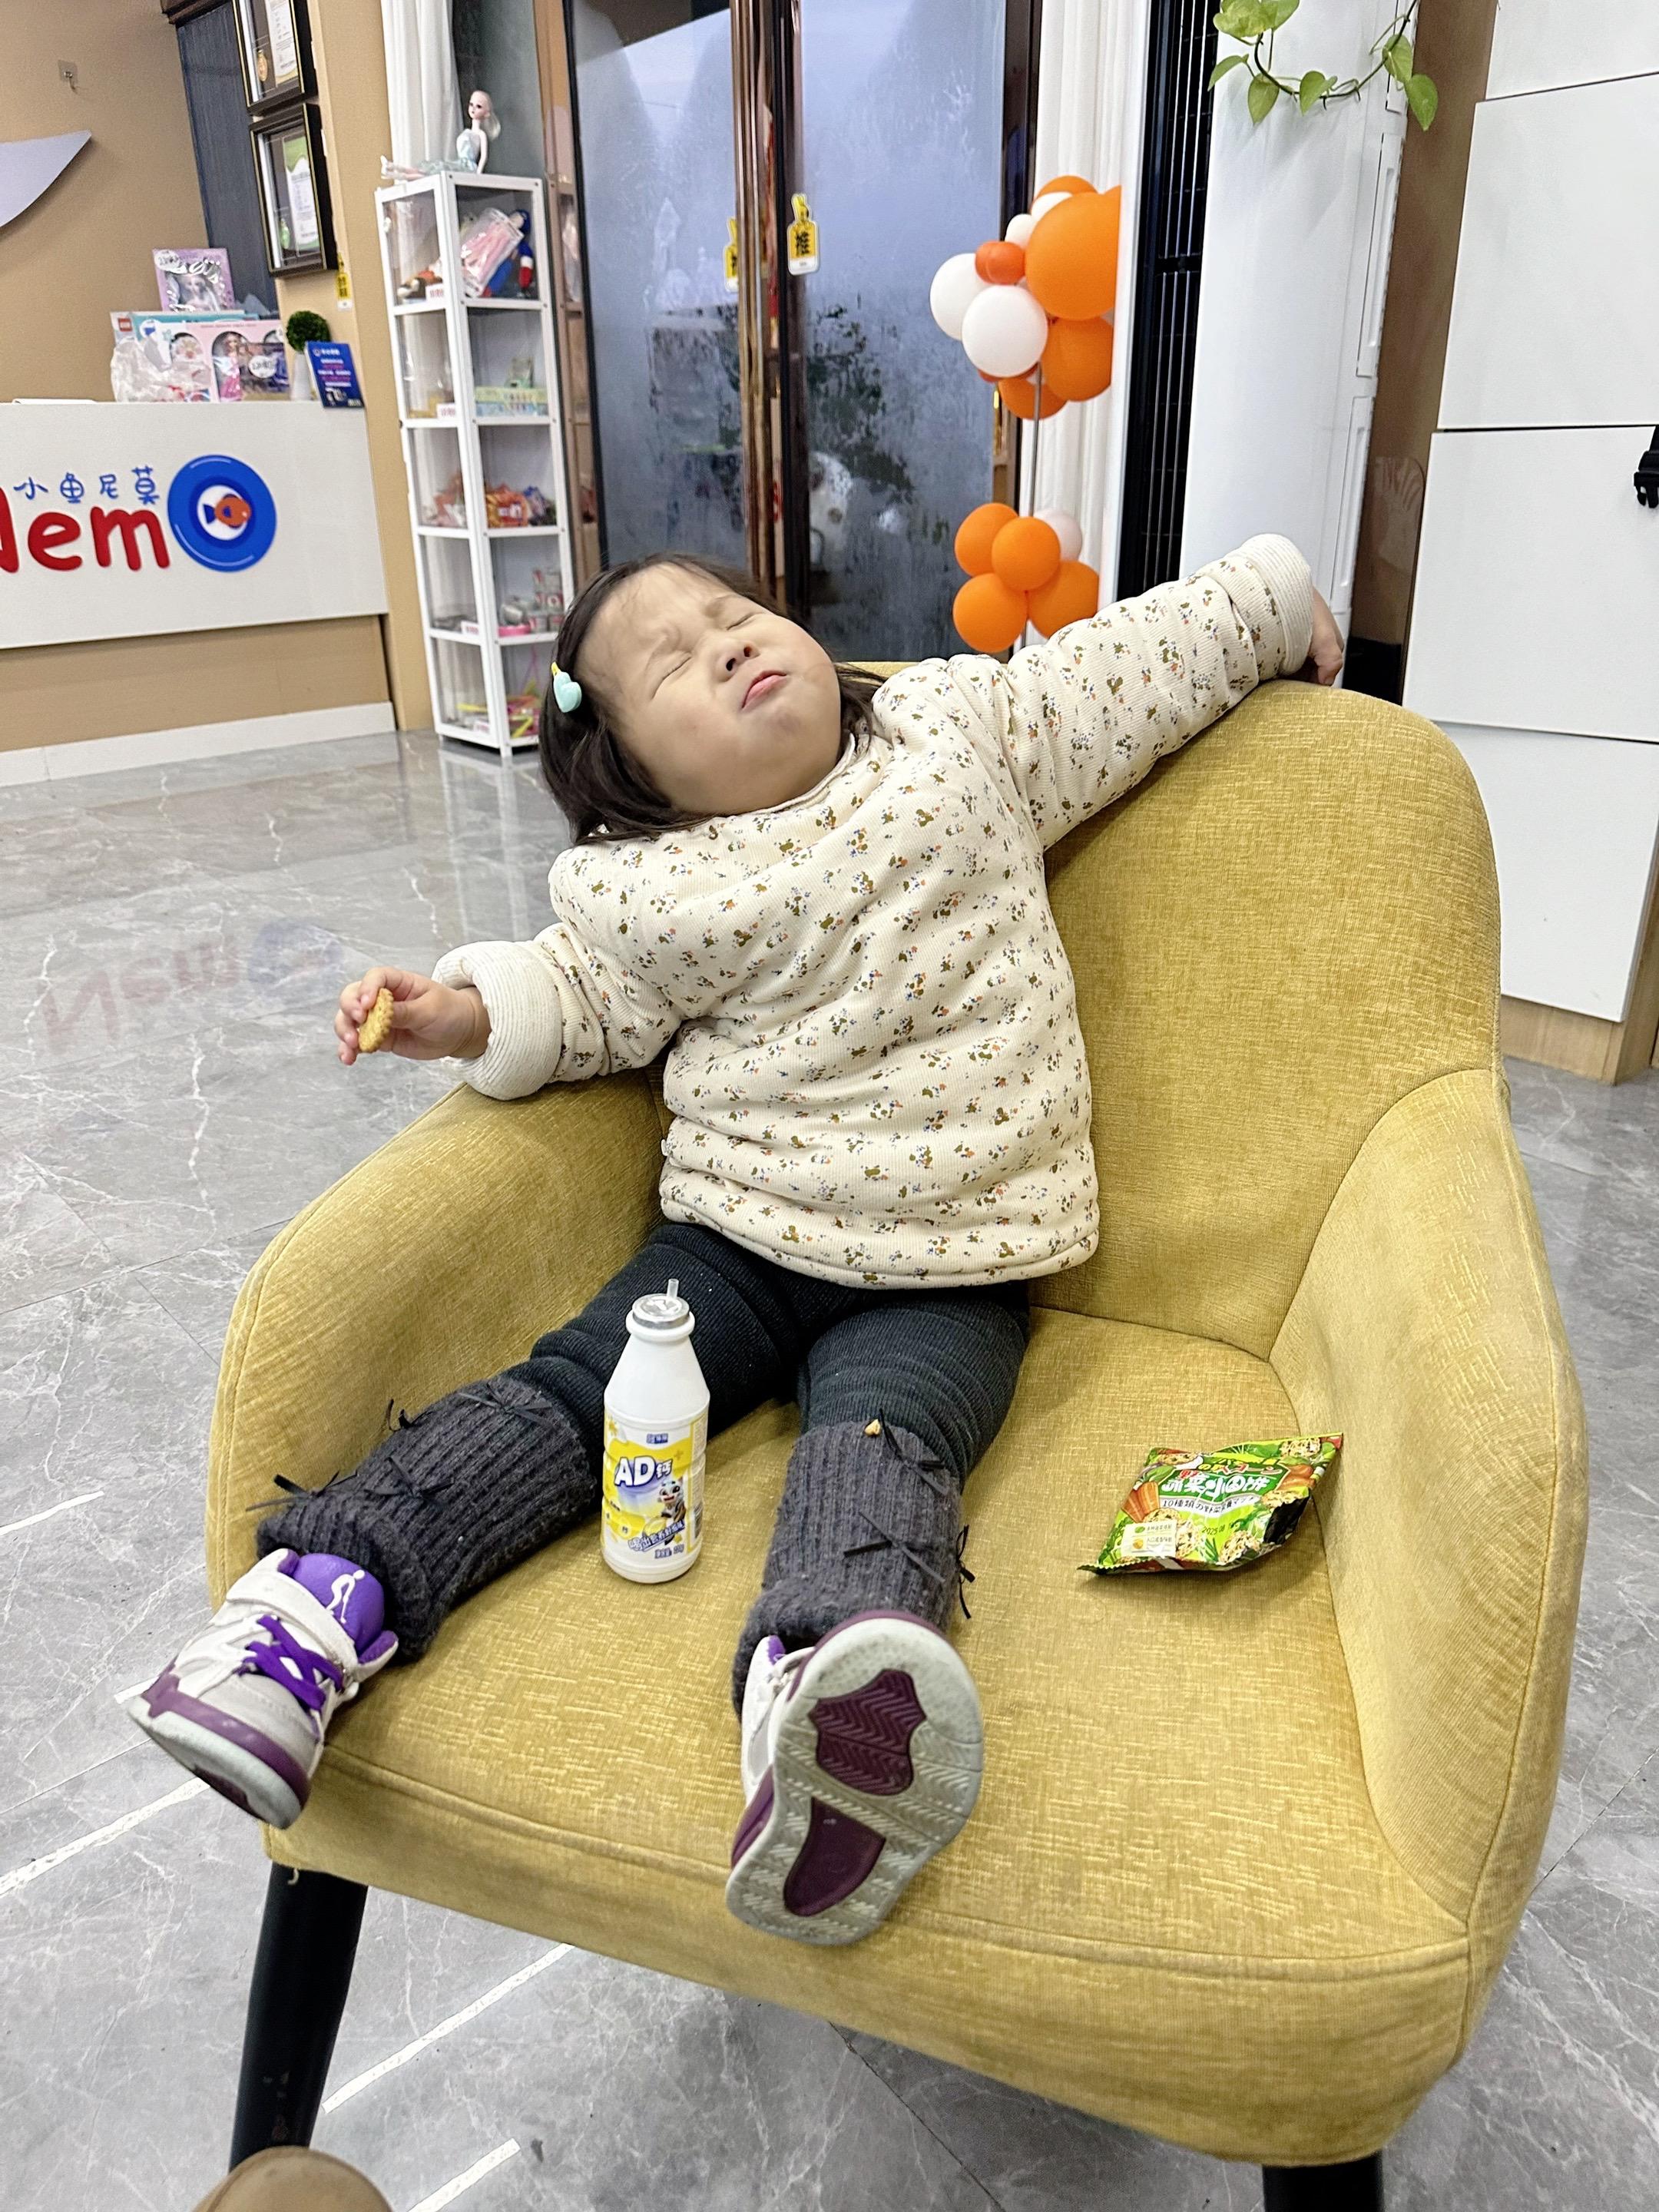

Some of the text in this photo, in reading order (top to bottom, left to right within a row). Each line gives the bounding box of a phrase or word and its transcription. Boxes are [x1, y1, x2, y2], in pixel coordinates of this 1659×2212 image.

[13, 465, 159, 505] 小鱼尼莫
[614, 1455, 674, 1487] AD钙
